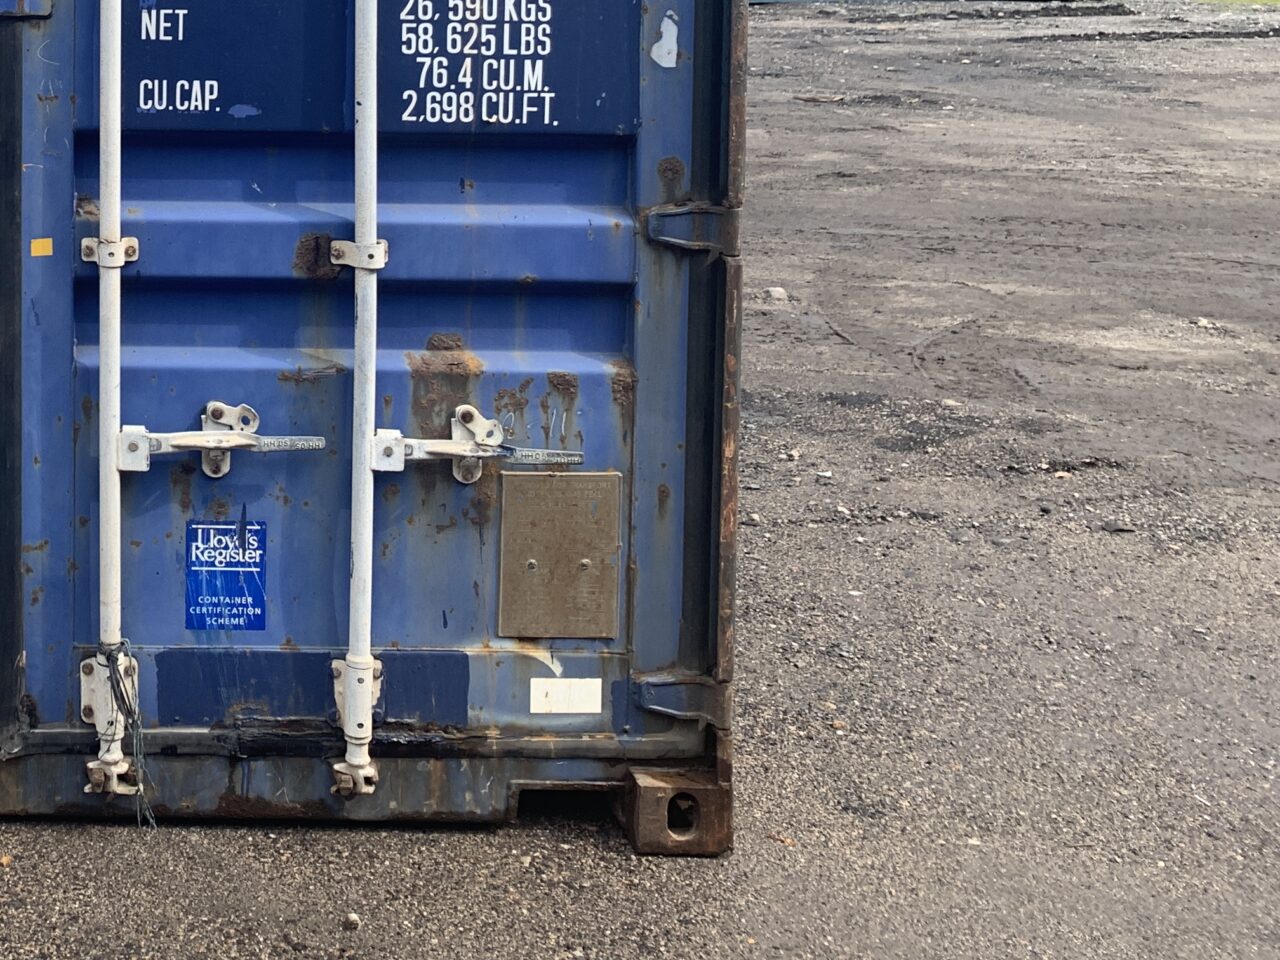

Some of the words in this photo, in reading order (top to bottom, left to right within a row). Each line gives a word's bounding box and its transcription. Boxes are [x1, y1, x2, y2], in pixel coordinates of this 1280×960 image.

[140, 9, 189, 41] NET
[503, 22, 552, 55] LBS
[416, 57, 474, 90] 76.4
[482, 59, 550, 91] CU.M.
[139, 78, 221, 112] CU.CAP.
[481, 92, 559, 125] CU.FT.
[192, 543, 263, 567] Register
[190, 607, 261, 615] CERTIFICATION
[198, 596, 253, 604] CONTAINER
[206, 617, 245, 625] SCHEME
